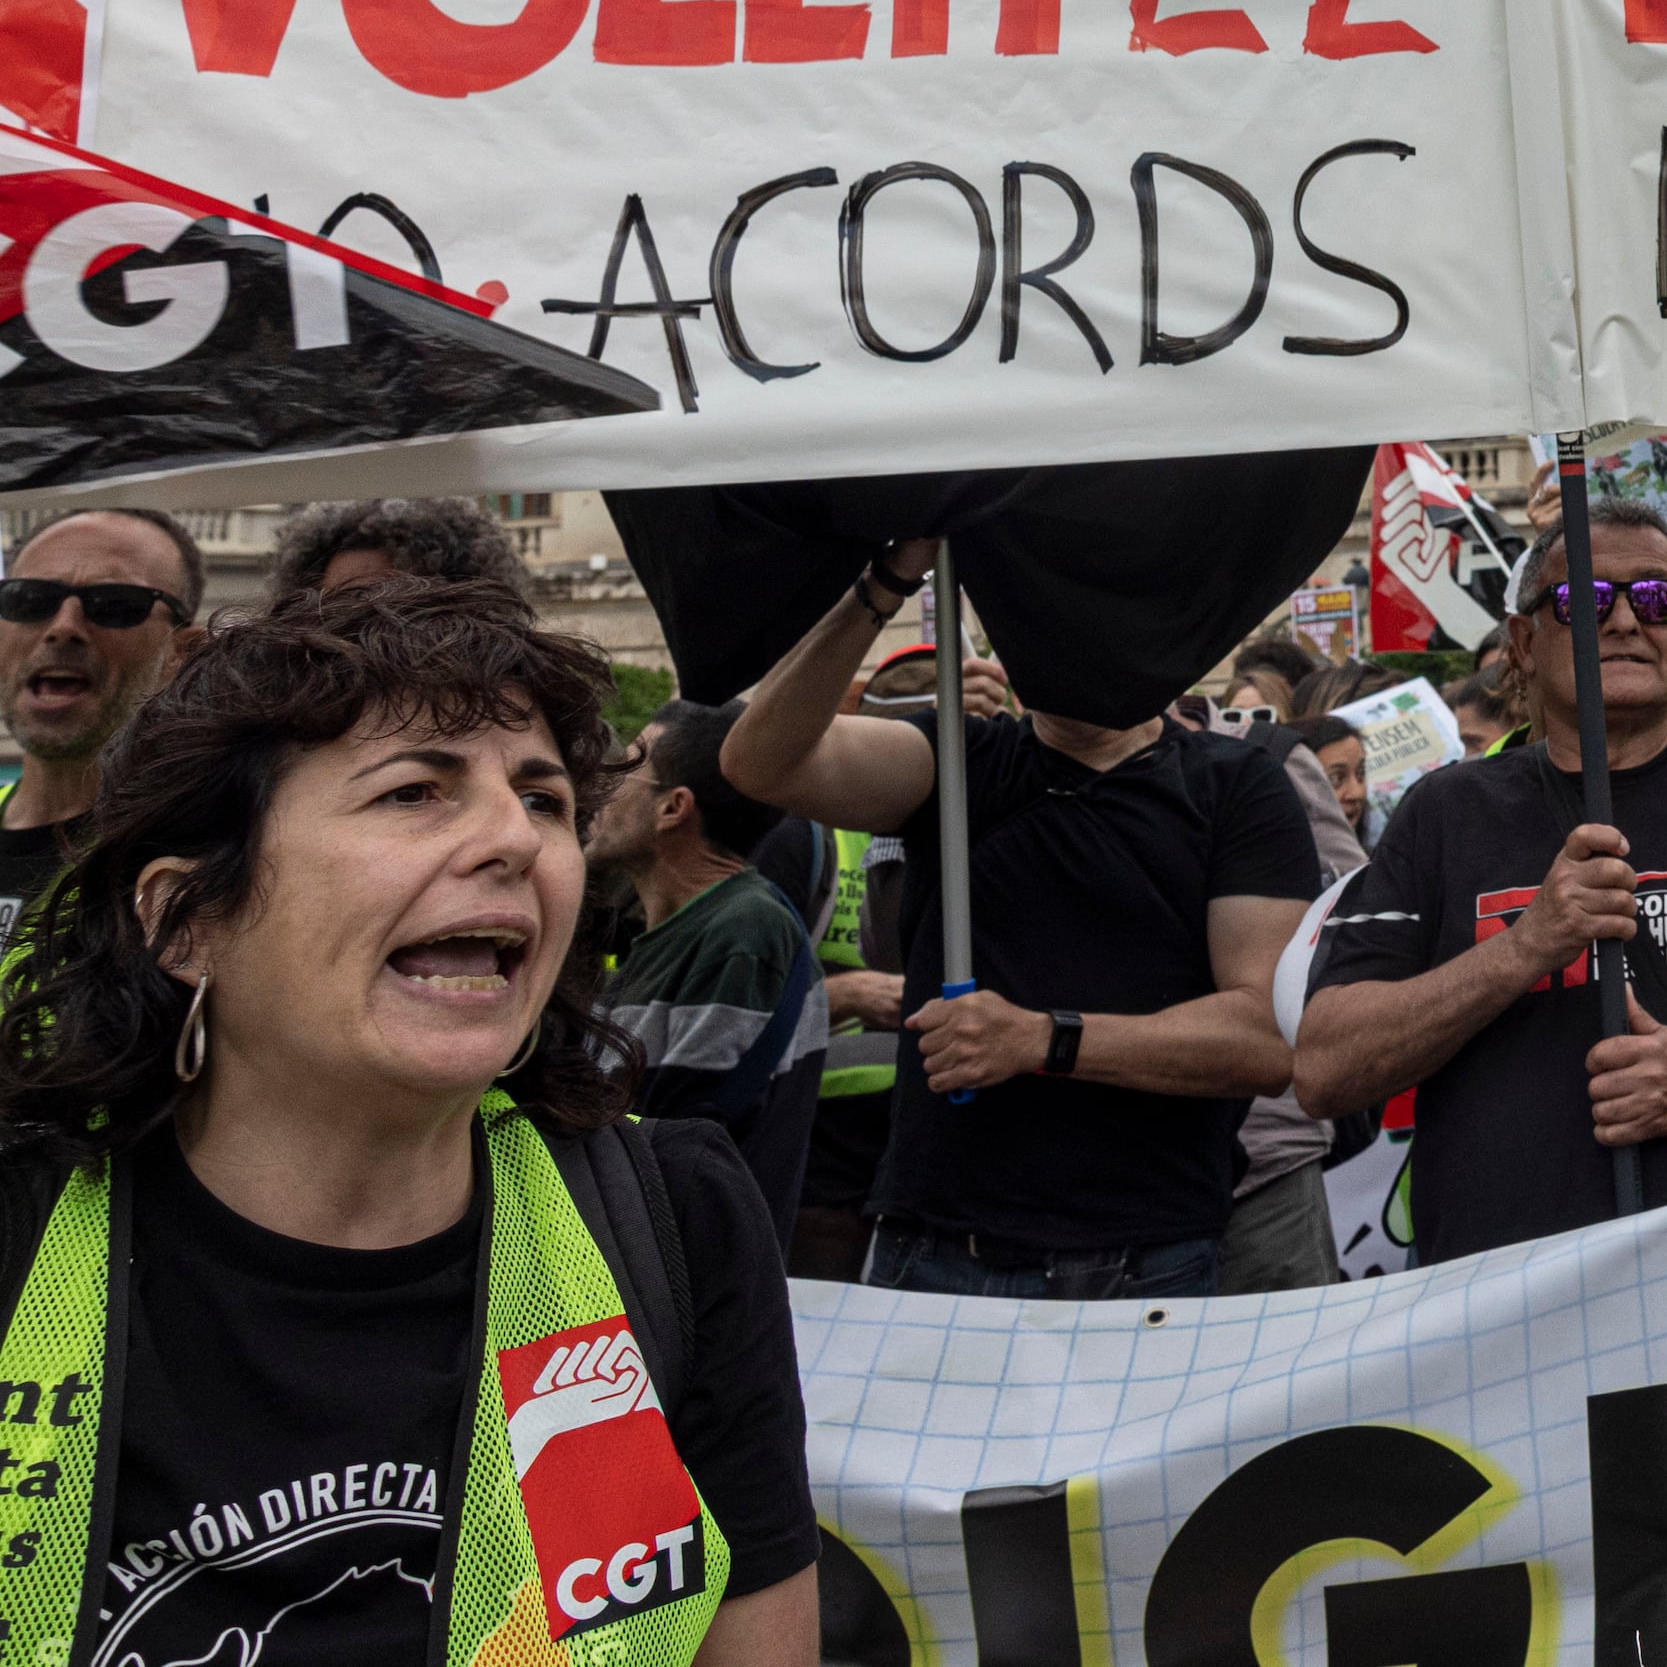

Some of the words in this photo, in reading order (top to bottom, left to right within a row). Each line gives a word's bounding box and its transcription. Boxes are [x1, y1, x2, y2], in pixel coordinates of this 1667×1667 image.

[0, 200, 351, 381] GT
[541, 139, 1416, 413] ACORDS
[260, 1461, 437, 1534] DIRECTA
[555, 1524, 695, 1620] CGT
